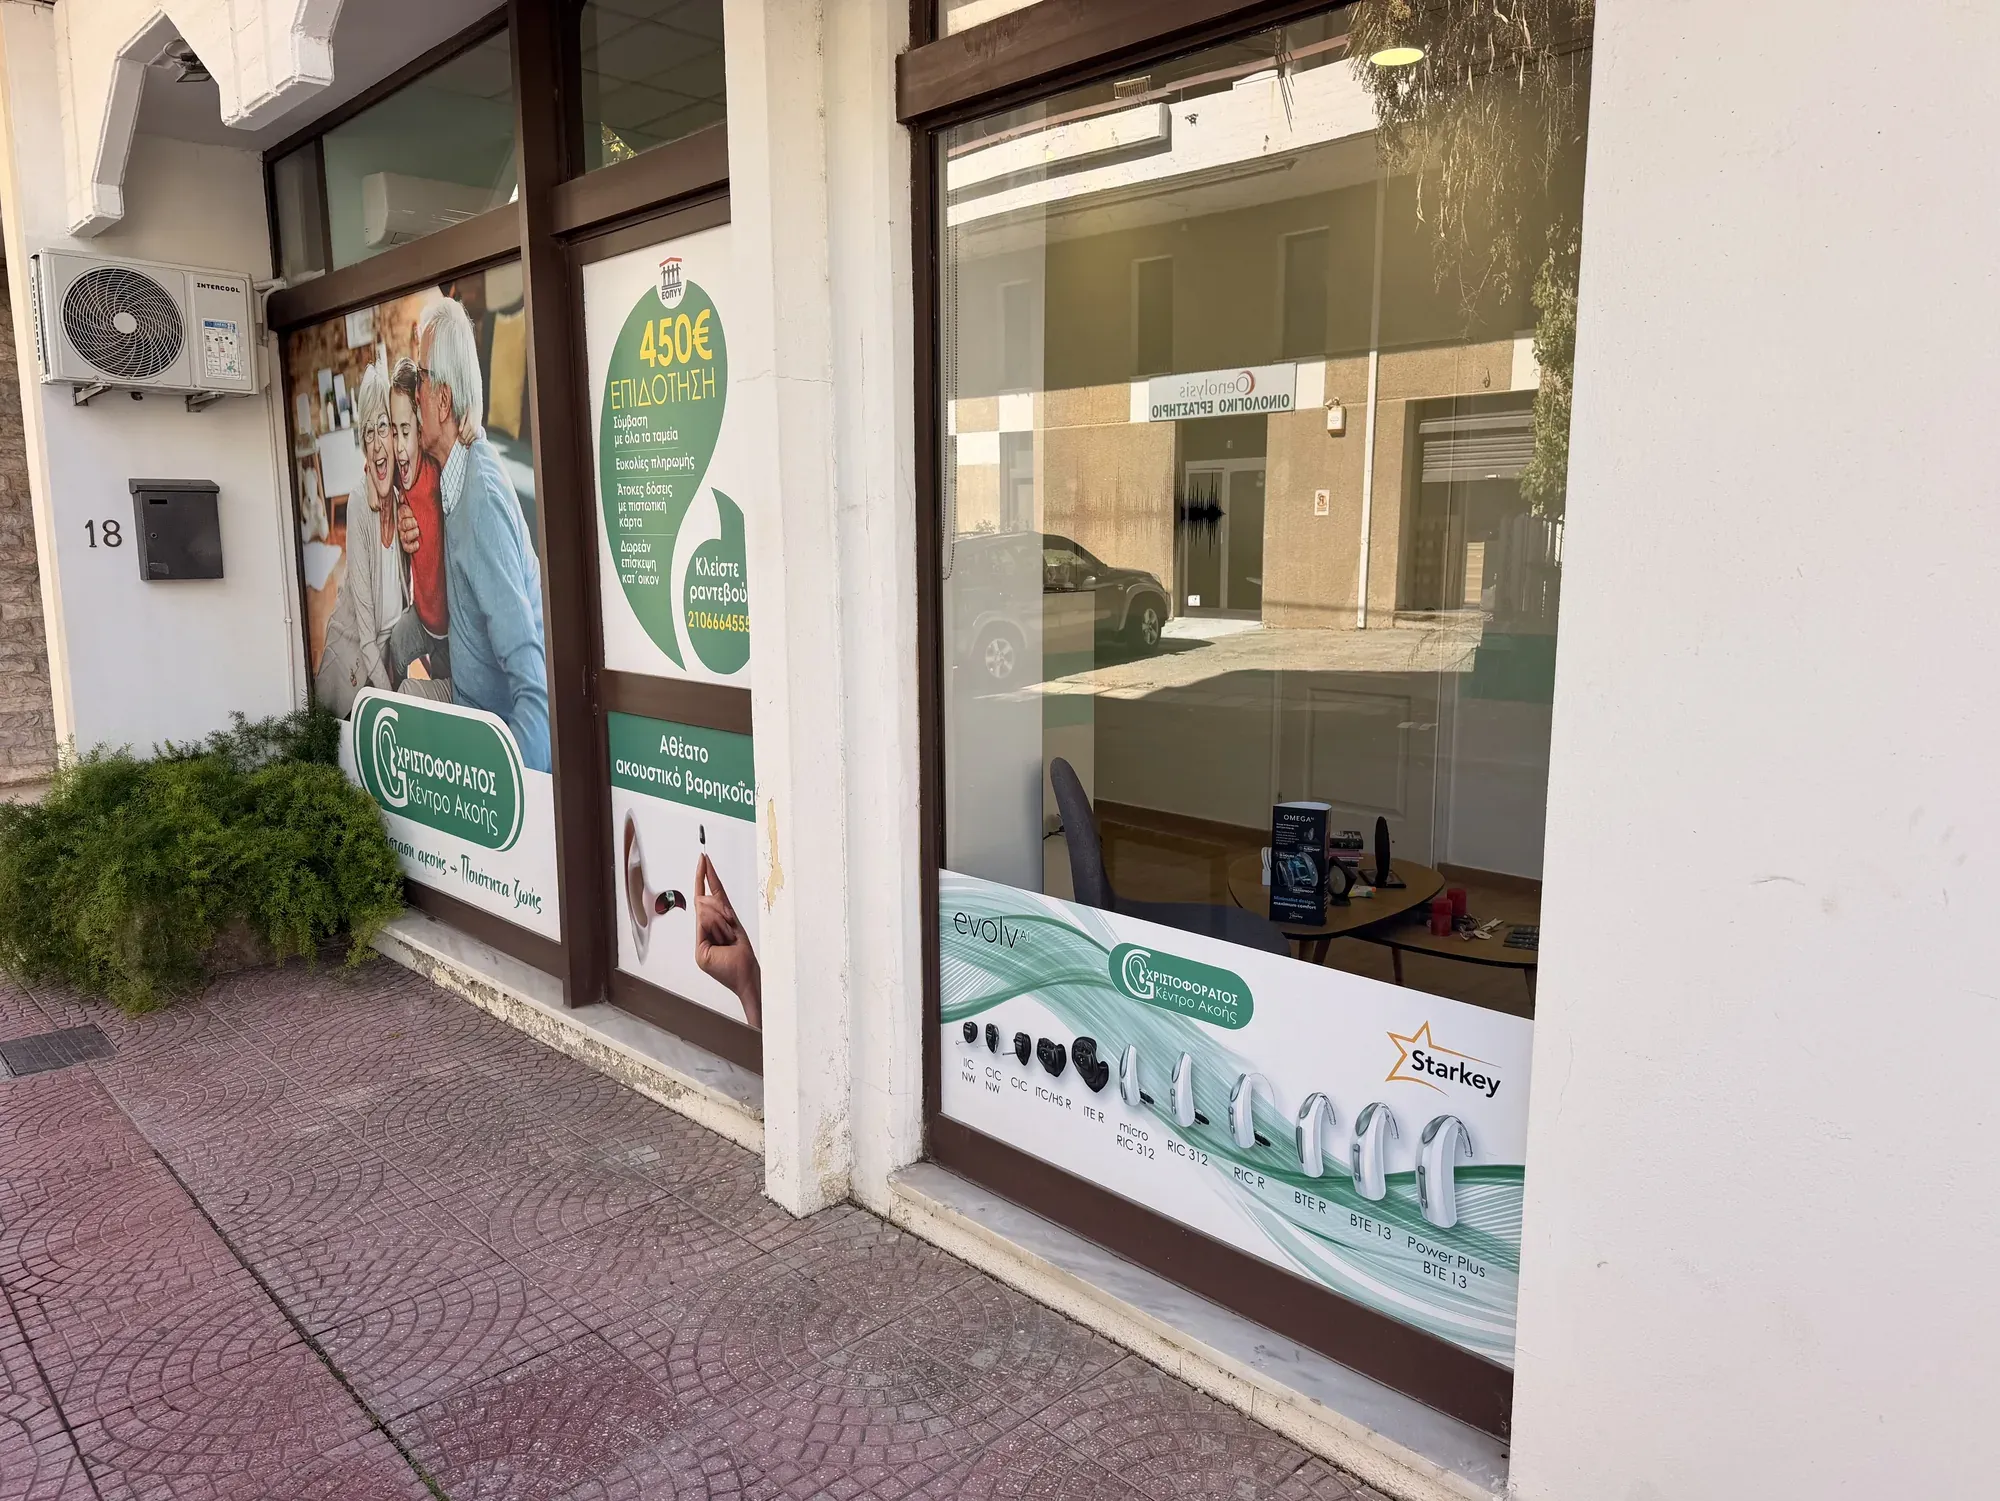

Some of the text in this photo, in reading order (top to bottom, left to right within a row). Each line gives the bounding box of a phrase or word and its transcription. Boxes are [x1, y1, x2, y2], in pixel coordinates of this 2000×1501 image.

[197, 282, 240, 293] INTERCOOL
[661, 287, 682, 300] ΕΟΠΥΥ
[639, 308, 713, 367] 450€
[611, 367, 715, 410] ΕΠΙΔΟΤΗΣΗ
[613, 414, 648, 431] Σύμβαση
[614, 426, 678, 448] με όλα τα ταμεία
[615, 452, 695, 472] Ευκολίες πληρωμής
[616, 480, 673, 498] Άτοκες δόσεις
[618, 497, 667, 514] με πιστωτική
[84, 519, 123, 548] 18
[619, 514, 642, 530] κάρτα
[620, 539, 651, 555] Δωρεάν
[621, 555, 657, 572] επίσκεψη
[695, 556, 740, 577] Κλείστε
[690, 581, 747, 606] ραντεβού
[659, 734, 709, 763] Αθέατο
[396, 745, 497, 796] ΧΡΙΣΤΟΦΟΡΑΤΟΣ
[616, 758, 681, 788] ακουστικό
[408, 777, 498, 836] Κέντρο Ακοής
[1283, 814, 1311, 823] OMEGA
[418, 851, 447, 875] ακοής
[460, 853, 511, 898] Ποιότητα
[513, 877, 542, 914] ζωής
[953, 911, 1018, 948] evolv
[1146, 969, 1238, 1006] ΧΡΙΣΤΟΦΟΡΑΤΟΣ
[1155, 985, 1237, 1024] Κέντρο Ακοής
[961, 1071, 976, 1084] NW
[985, 1066, 1002, 1081] CIC
[1010, 1076, 1028, 1092] CIC
[1411, 1049, 1501, 1098] Starkey
[985, 1081, 1000, 1094] NW
[1034, 1087, 1072, 1110] ITC/HS R
[1083, 1105, 1105, 1123] ITE R
[1119, 1121, 1149, 1141] micro
[1116, 1135, 1155, 1160] RIC 312
[1167, 1140, 1208, 1166] RIC 312
[1233, 1166, 1265, 1189] RIC R
[1294, 1191, 1327, 1214] BTE R
[1350, 1213, 1392, 1240] BTE 13
[1407, 1236, 1486, 1278] Power Plus
[1423, 1260, 1468, 1289] BTE 13
